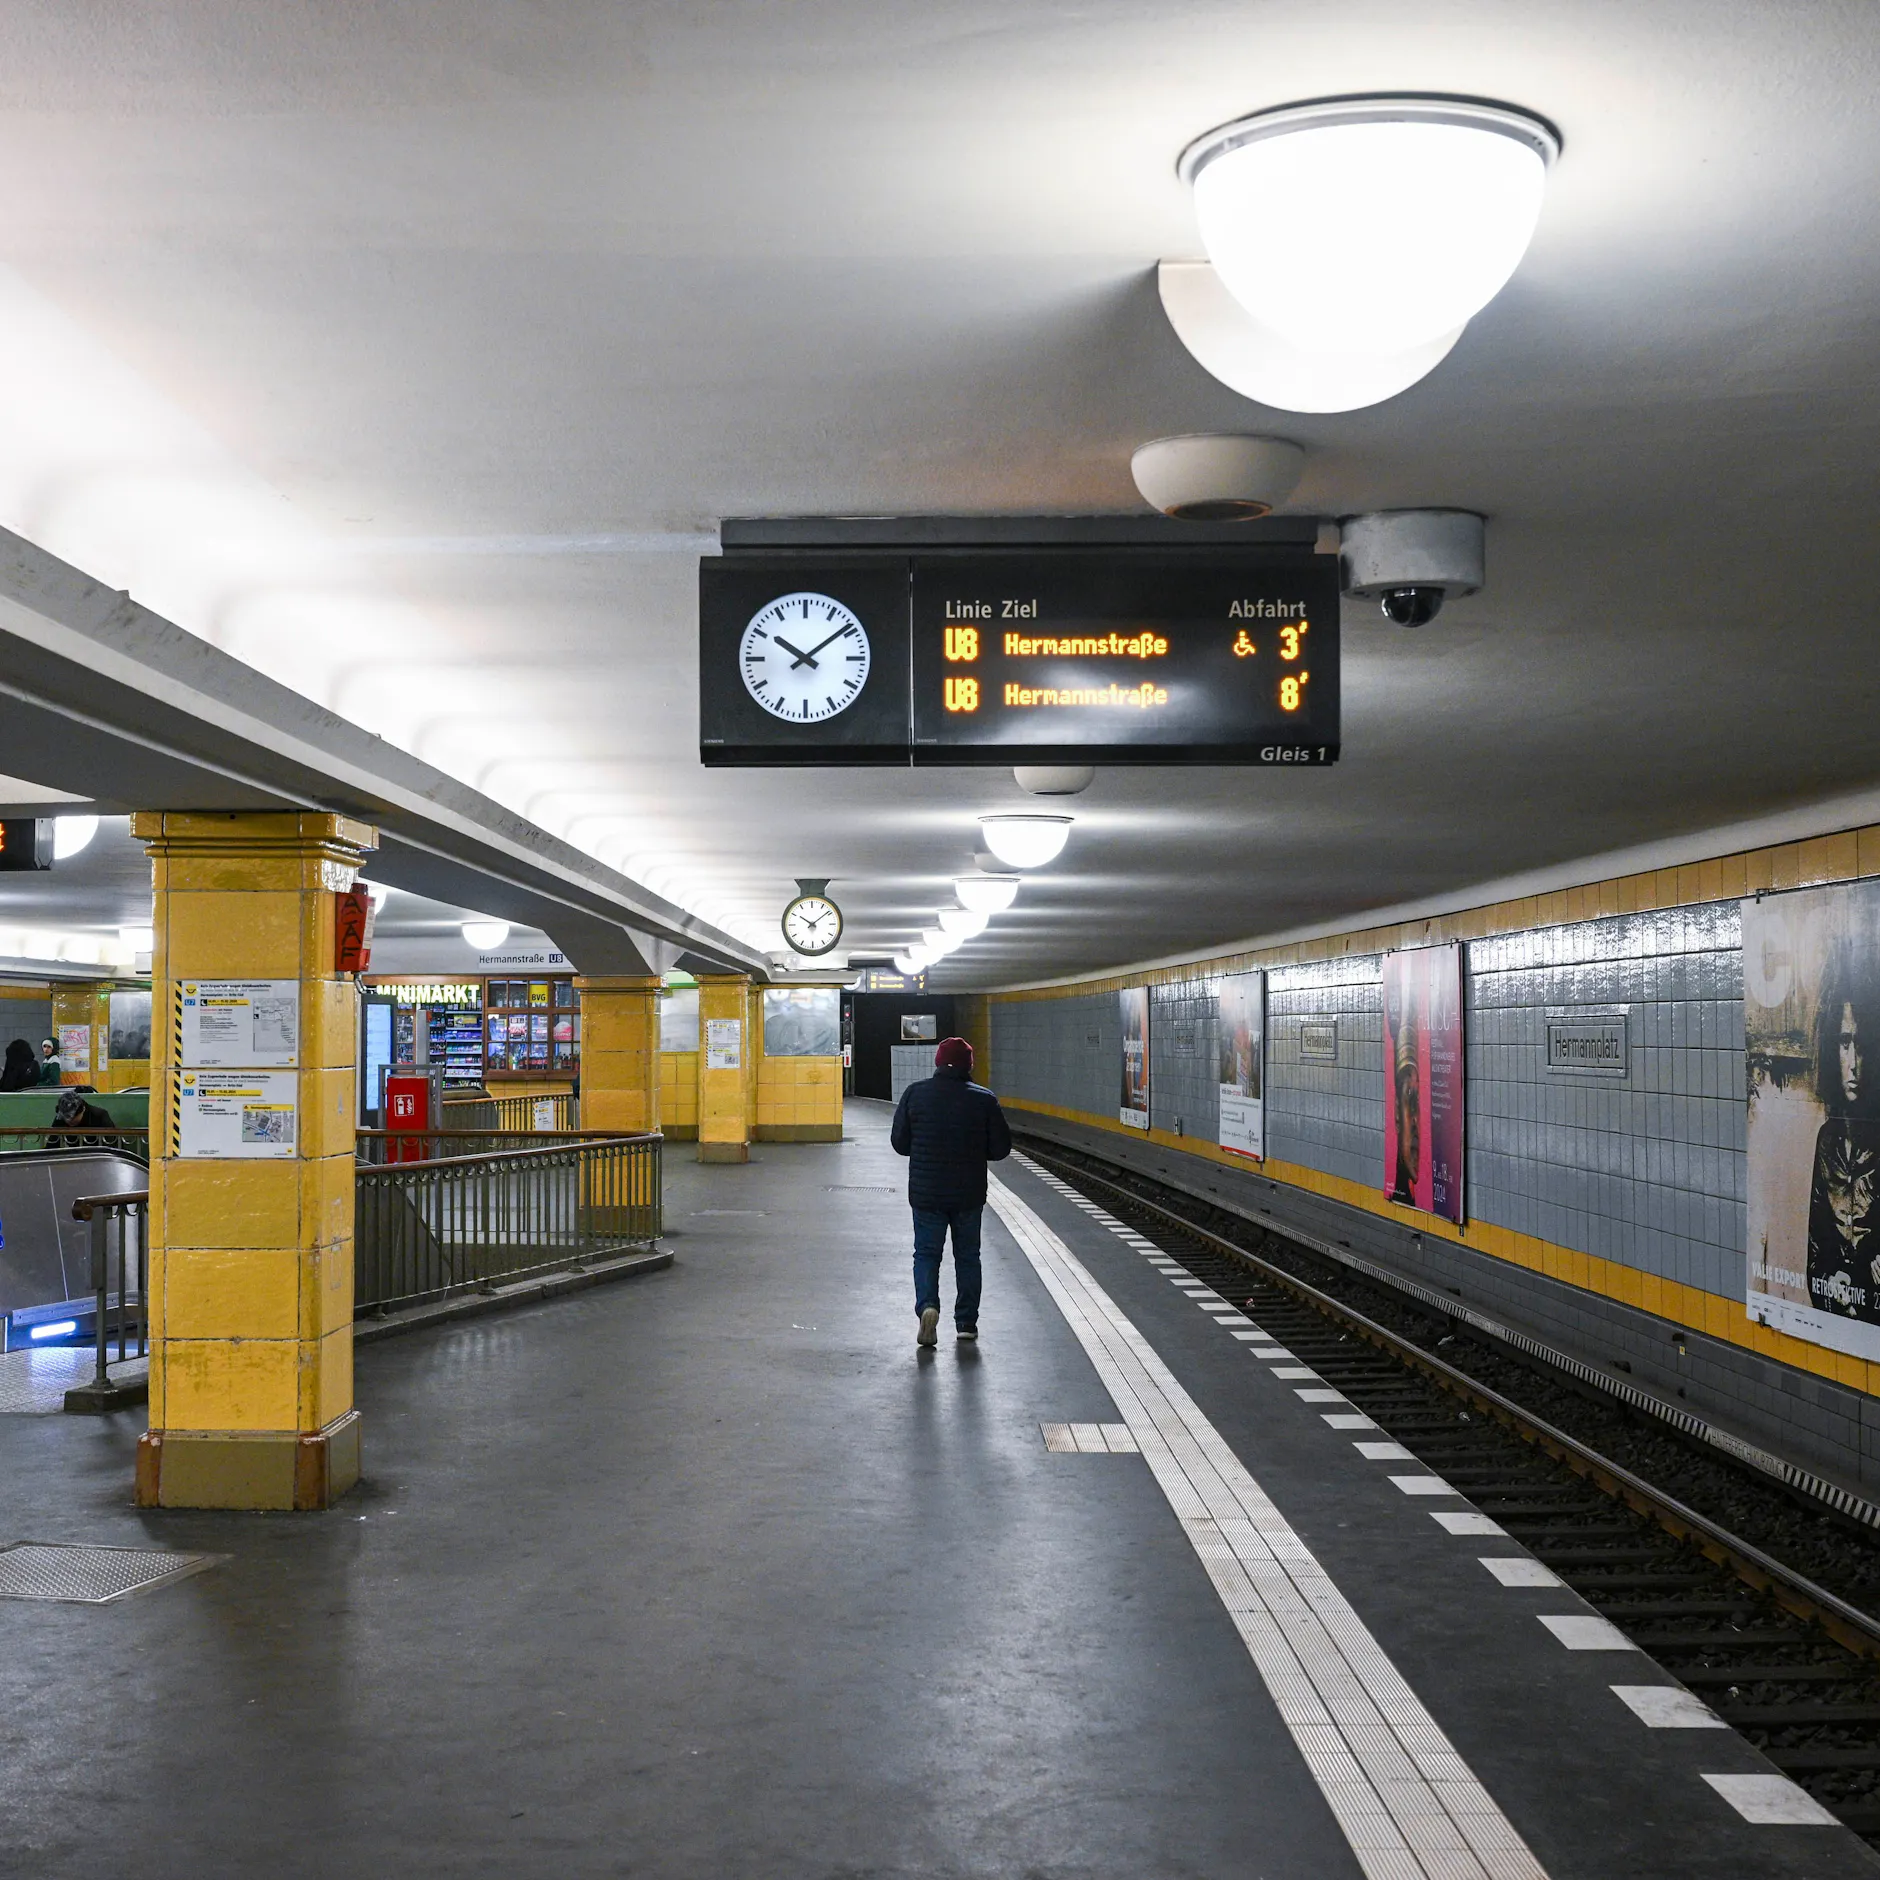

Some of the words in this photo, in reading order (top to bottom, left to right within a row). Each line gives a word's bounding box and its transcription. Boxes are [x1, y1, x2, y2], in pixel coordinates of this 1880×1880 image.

[945, 600, 992, 618] Linie
[1001, 599, 1037, 618] Ziel
[1228, 599, 1307, 618] Abfahrt
[944, 627, 979, 661] U8
[1004, 632, 1168, 659] Hermannstraße
[944, 678, 979, 712] U8
[1004, 683, 1168, 709] Hermannstraße
[1260, 746, 1310, 762] Gleis
[1317, 747, 1326, 761] 1
[479, 953, 545, 964] Hermannstraße
[549, 953, 563, 963] U8
[1555, 1030, 1620, 1064] Hermannplatz
[1774, 1267, 1806, 1290] EXPORT
[1812, 1277, 1866, 1306] RETROSPEKTIVE
